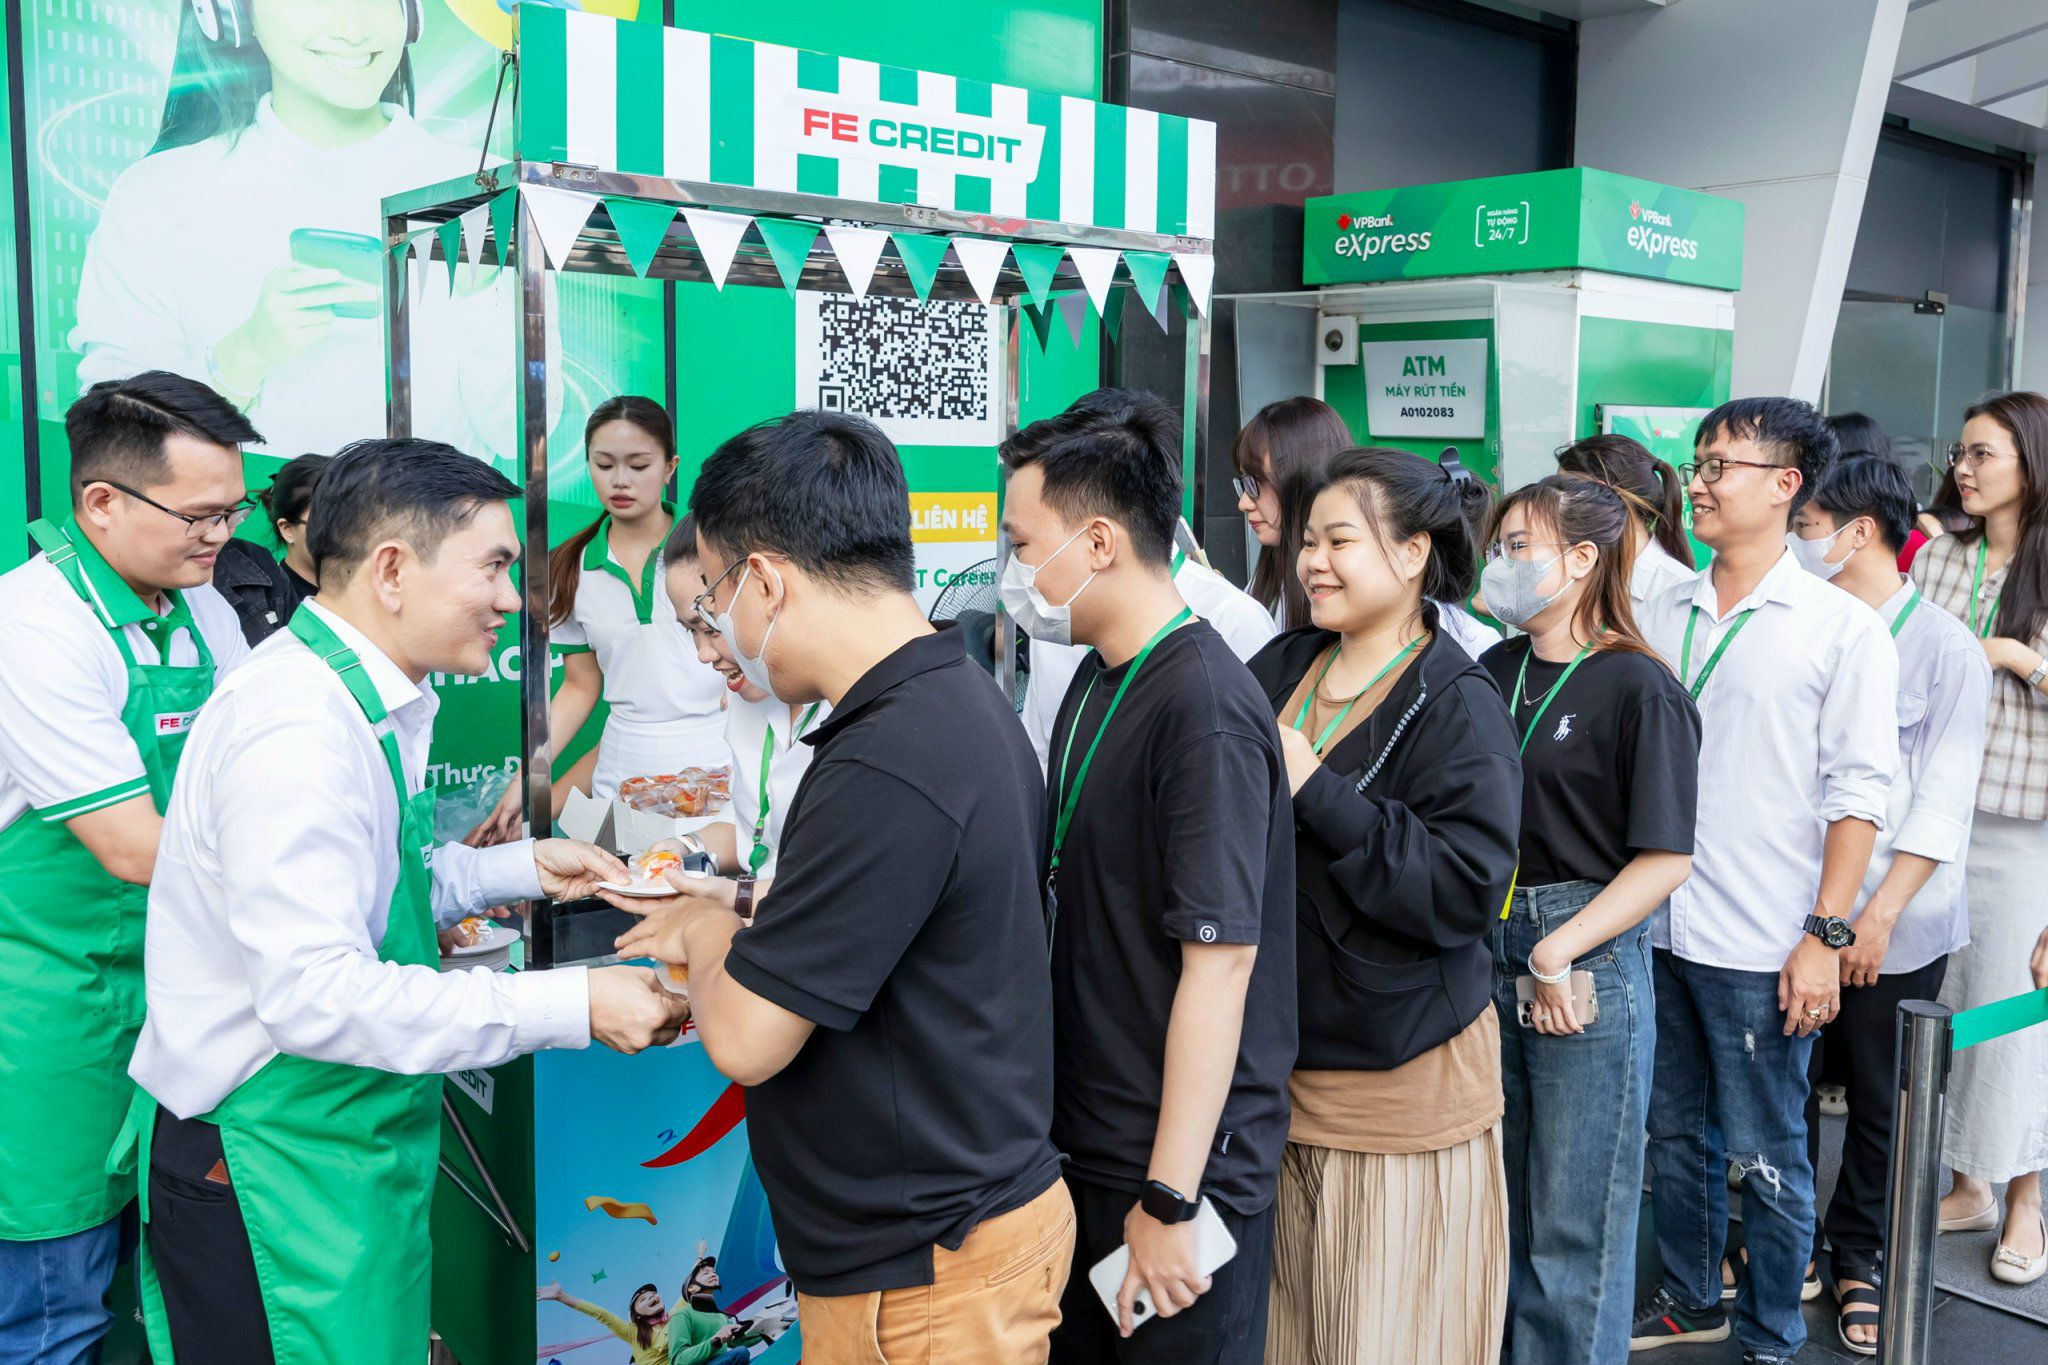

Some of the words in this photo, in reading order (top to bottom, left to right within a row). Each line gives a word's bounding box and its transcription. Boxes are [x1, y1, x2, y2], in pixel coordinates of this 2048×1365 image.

[804, 108, 859, 143] FE
[869, 118, 1022, 163] CREDIT
[1353, 214, 1393, 229] VPBank
[1642, 208, 1672, 227] VPBank
[1489, 227, 1515, 240] 24/7
[1627, 225, 1698, 260] eXpress
[1335, 232, 1432, 262] eXpress
[1403, 355, 1445, 376] ATM
[1401, 407, 1454, 418] A0102083
[913, 504, 957, 529] LIÊN
[962, 504, 988, 535] HỆ
[934, 568, 996, 588] Career
[160, 718, 180, 729] FE
[427, 762, 496, 790] Thực
[681, 1020, 696, 1036] F
[459, 1070, 487, 1098] EDIT
